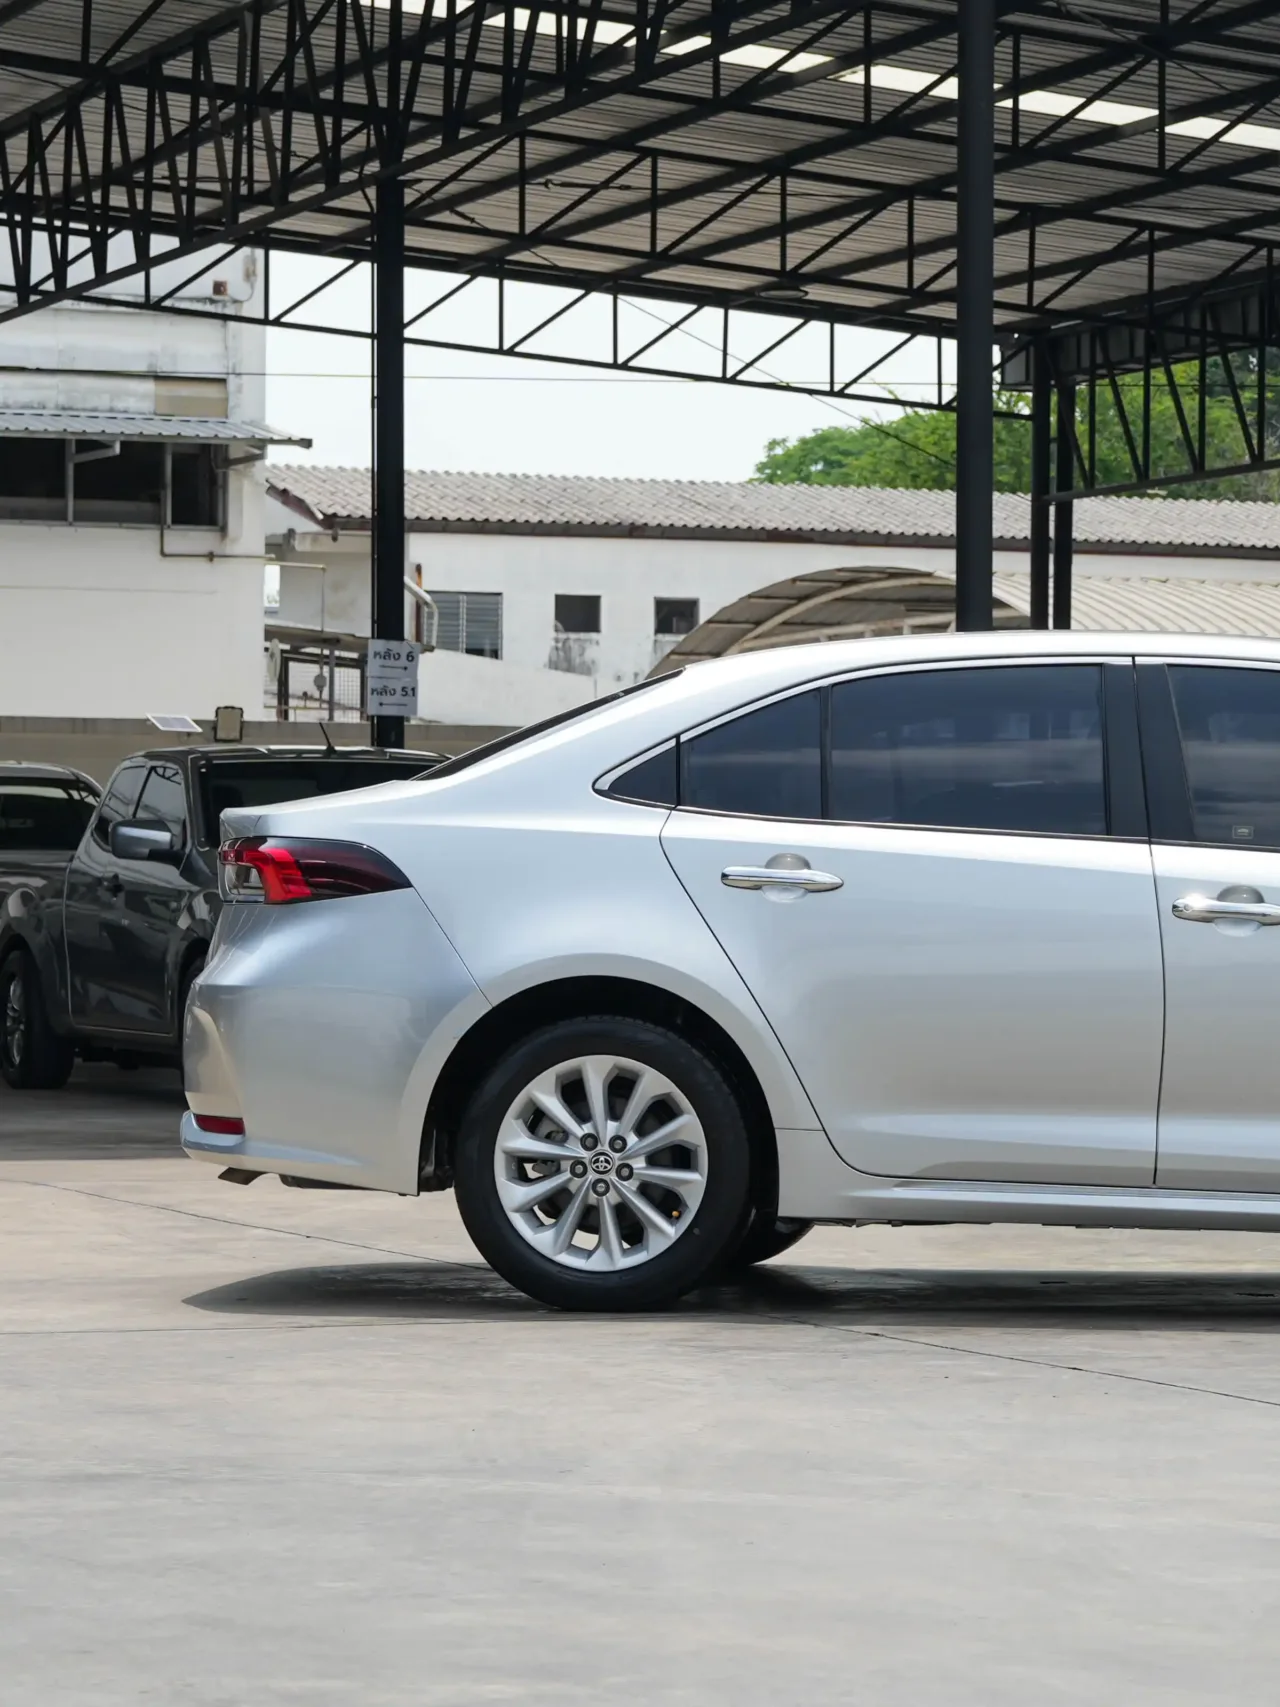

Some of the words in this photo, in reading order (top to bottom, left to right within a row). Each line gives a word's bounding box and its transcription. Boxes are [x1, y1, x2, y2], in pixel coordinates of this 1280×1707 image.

[373, 648, 401, 661] หลัง
[406, 651, 415, 662] 6
[371, 685, 397, 697] หลัง
